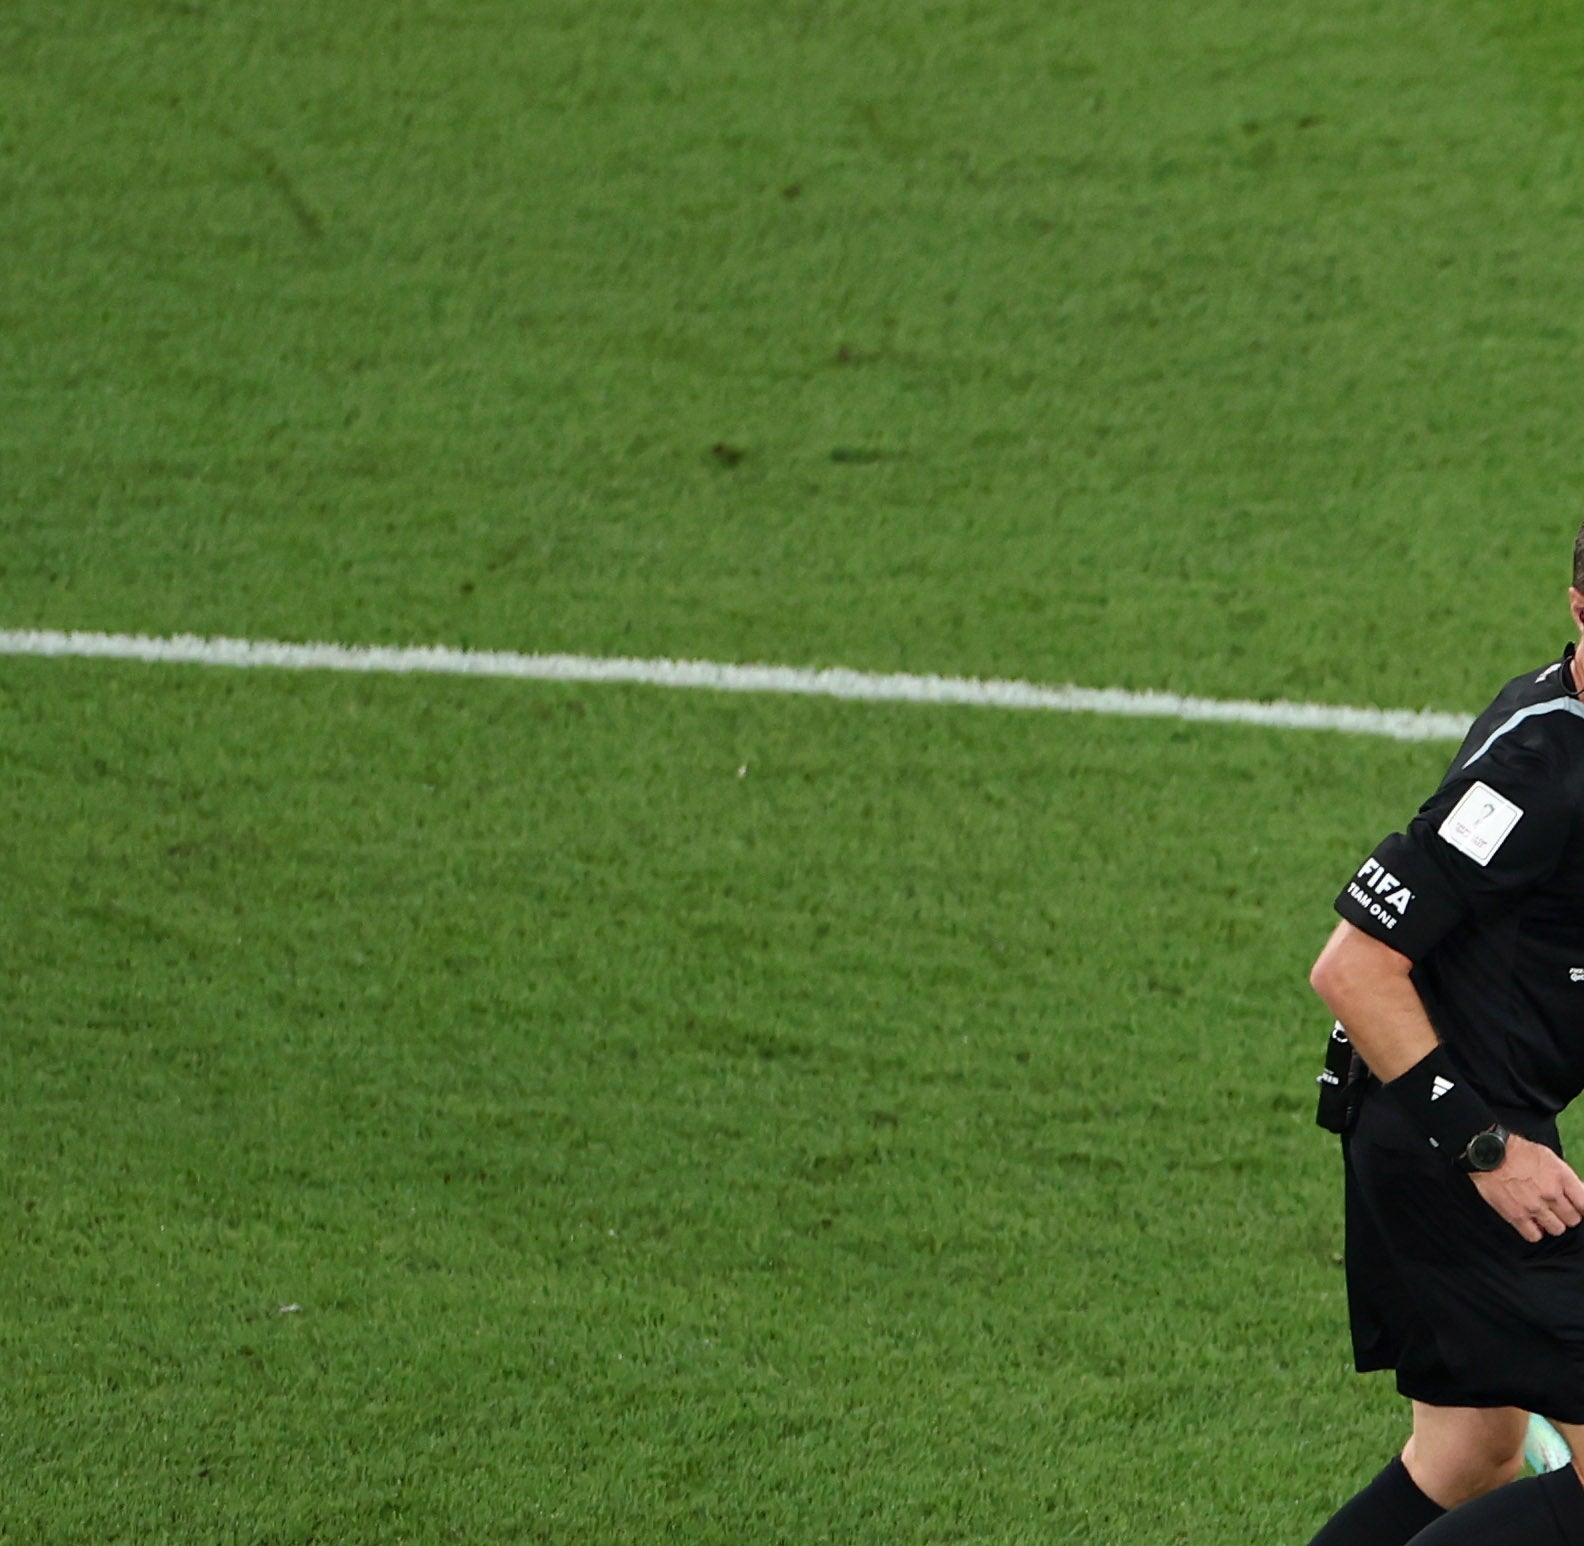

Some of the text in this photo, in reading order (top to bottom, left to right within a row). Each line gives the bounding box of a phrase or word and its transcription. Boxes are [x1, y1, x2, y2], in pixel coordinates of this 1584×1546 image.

[1348, 883, 1398, 929] TEAM ONE
[1357, 857, 1412, 915] FIFA
